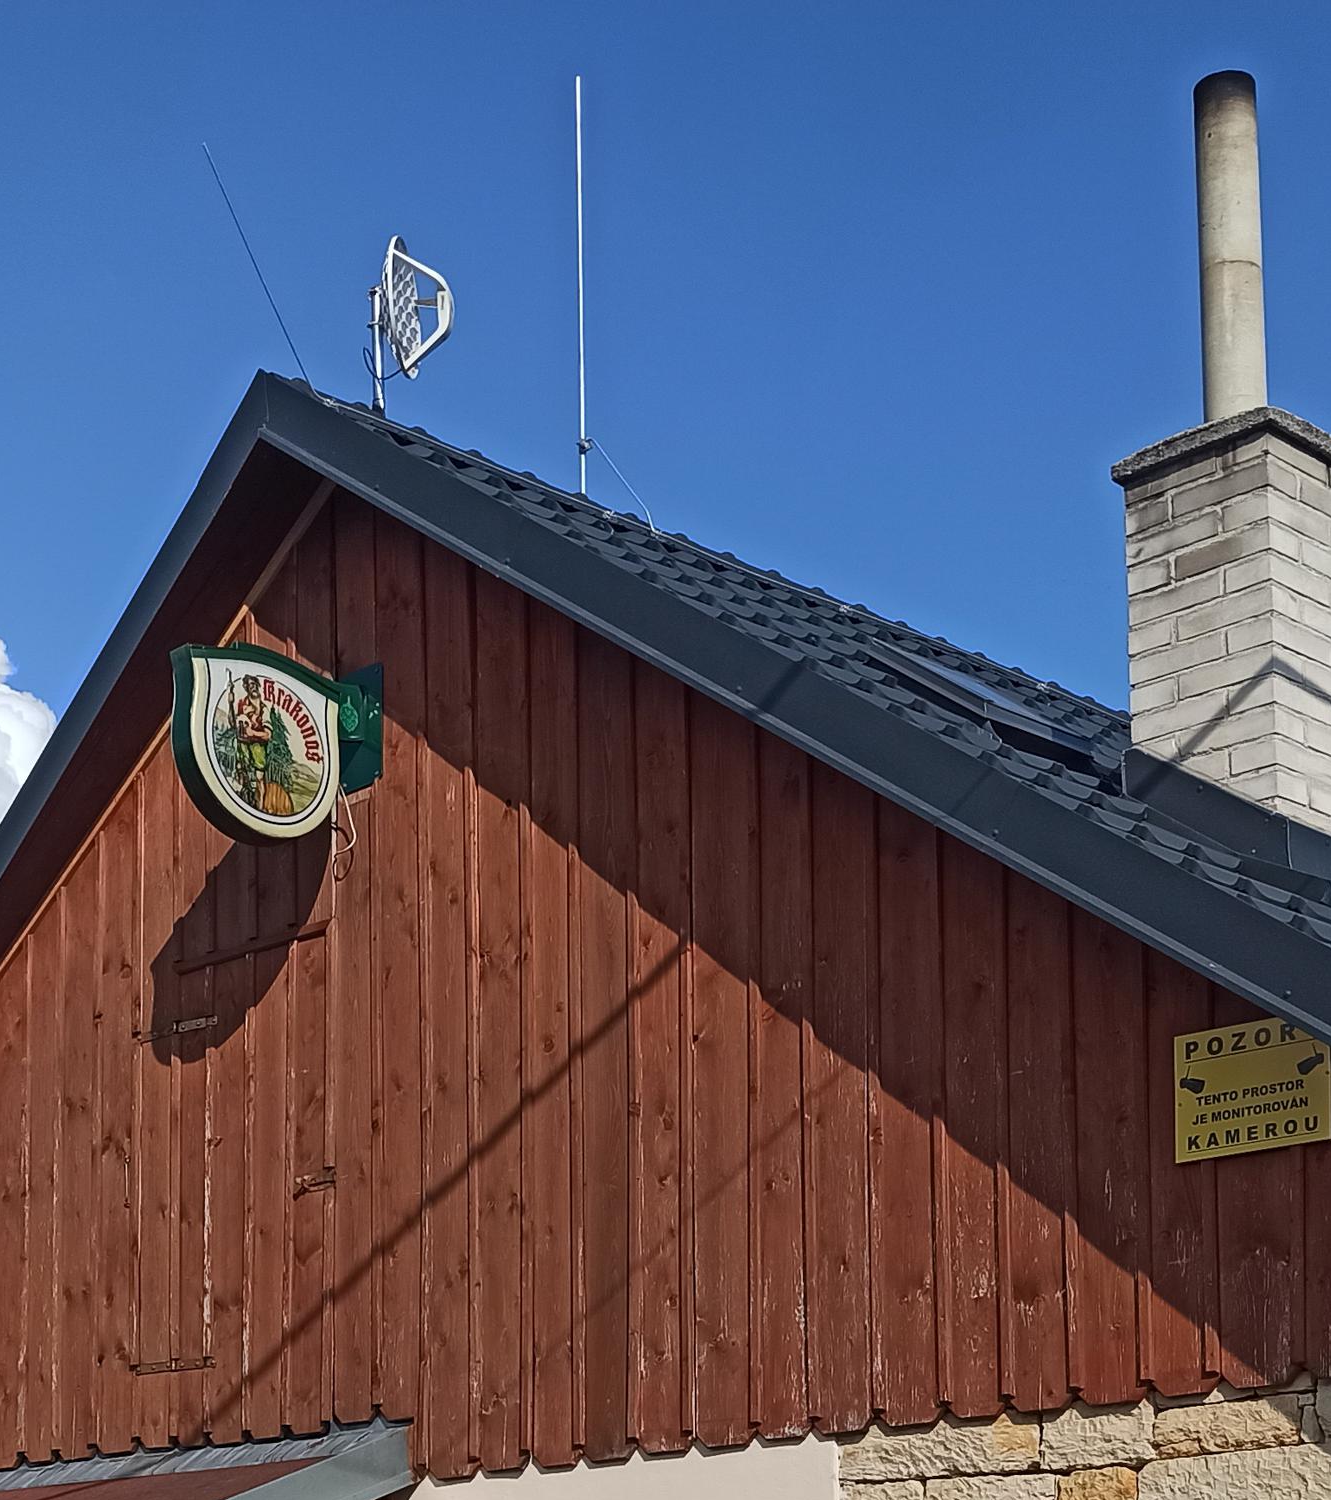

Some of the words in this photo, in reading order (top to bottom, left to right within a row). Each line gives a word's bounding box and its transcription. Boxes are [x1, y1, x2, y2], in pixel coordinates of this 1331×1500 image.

[1185, 1024, 1296, 1060] POZOR
[1196, 1091, 1238, 1106] TENTO
[1242, 1079, 1304, 1099] PROSTOR
[1192, 1114, 1207, 1126] JE
[1211, 1096, 1309, 1122] MONITOROVÁN
[1187, 1116, 1318, 1150] KAMEROU
